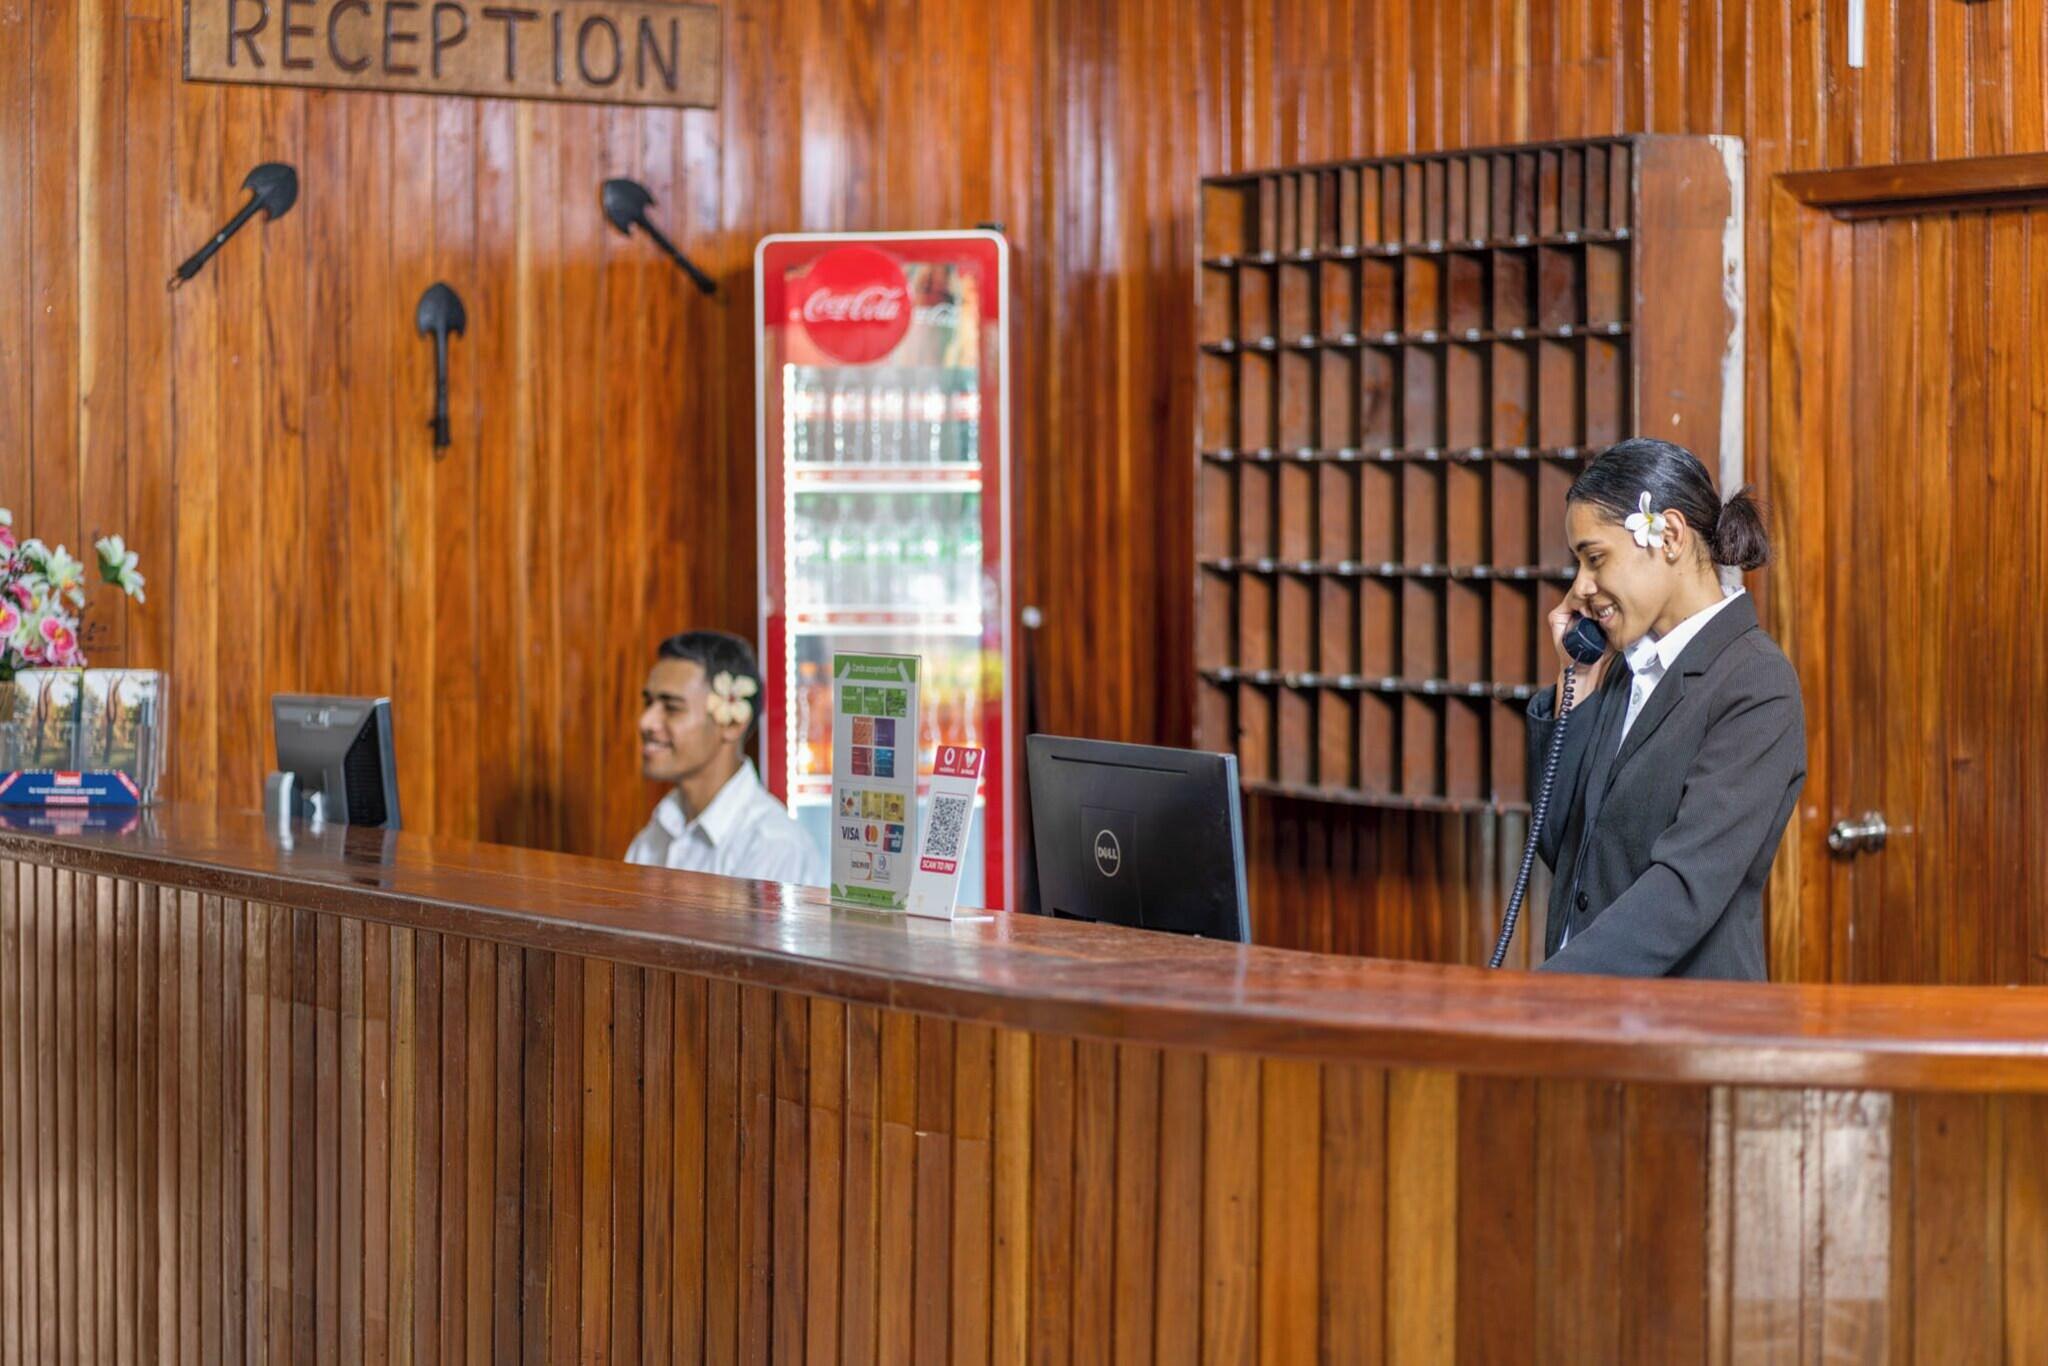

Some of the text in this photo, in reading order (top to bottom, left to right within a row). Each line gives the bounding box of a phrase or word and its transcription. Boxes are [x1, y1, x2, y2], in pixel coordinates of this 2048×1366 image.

[227, 0, 680, 91] RECEPTION
[841, 826, 860, 841] VISA
[1097, 846, 1118, 860] DELL
